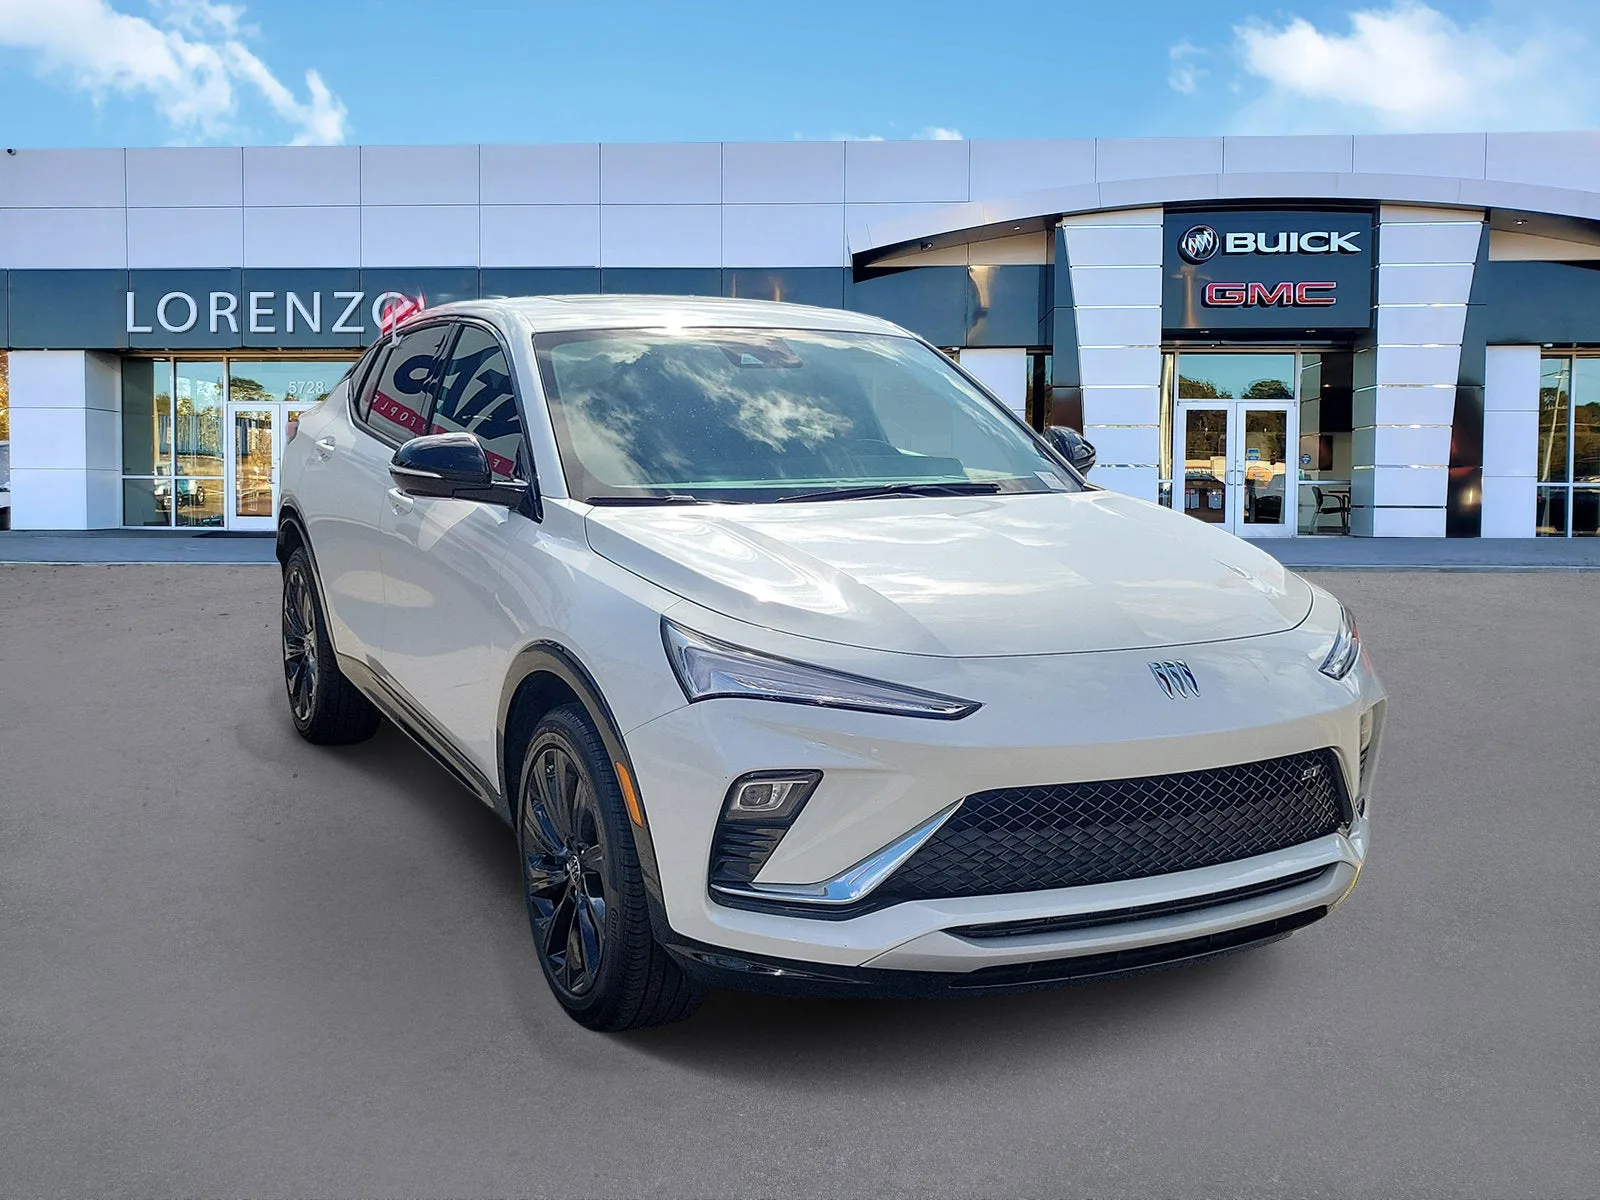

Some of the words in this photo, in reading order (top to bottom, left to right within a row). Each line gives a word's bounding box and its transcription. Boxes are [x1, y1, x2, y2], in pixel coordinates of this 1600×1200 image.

[1226, 231, 1362, 253] BUICK
[1205, 281, 1337, 305] GMC
[289, 380, 325, 394] 5728
